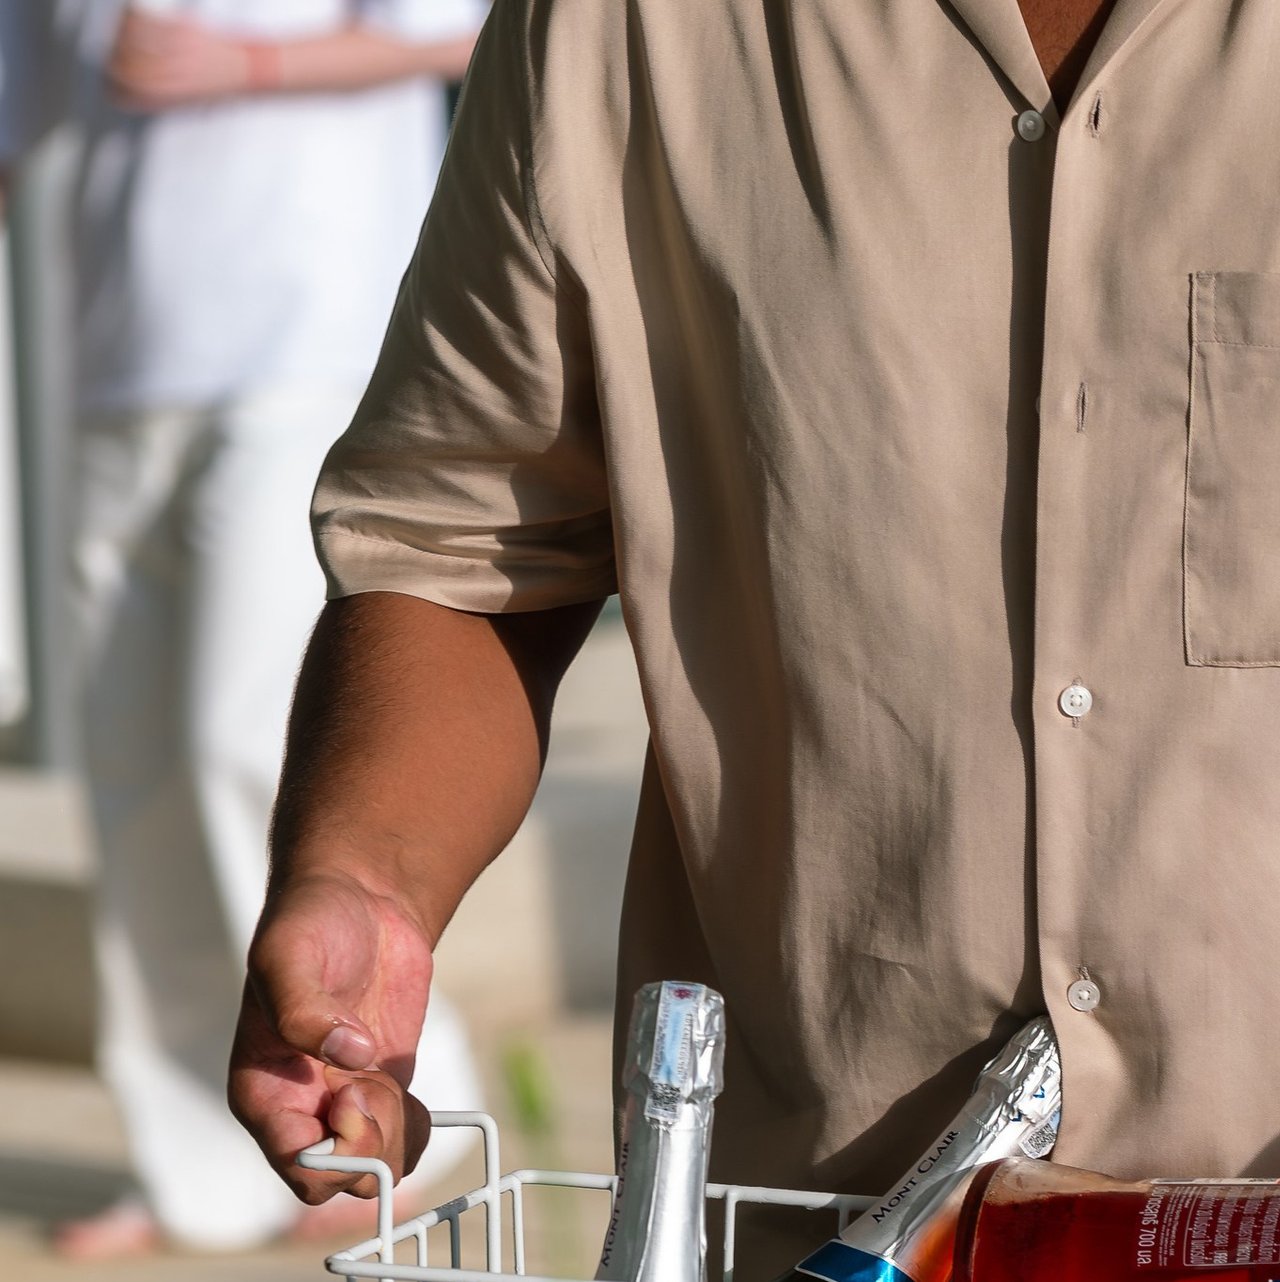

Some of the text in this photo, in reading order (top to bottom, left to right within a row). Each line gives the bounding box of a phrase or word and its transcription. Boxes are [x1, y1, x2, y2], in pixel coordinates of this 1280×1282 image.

[601, 1141, 630, 1267] MONT CLAIR
[871, 1130, 960, 1224] MONT CLAIR
[1138, 1227, 1157, 1247] 700
